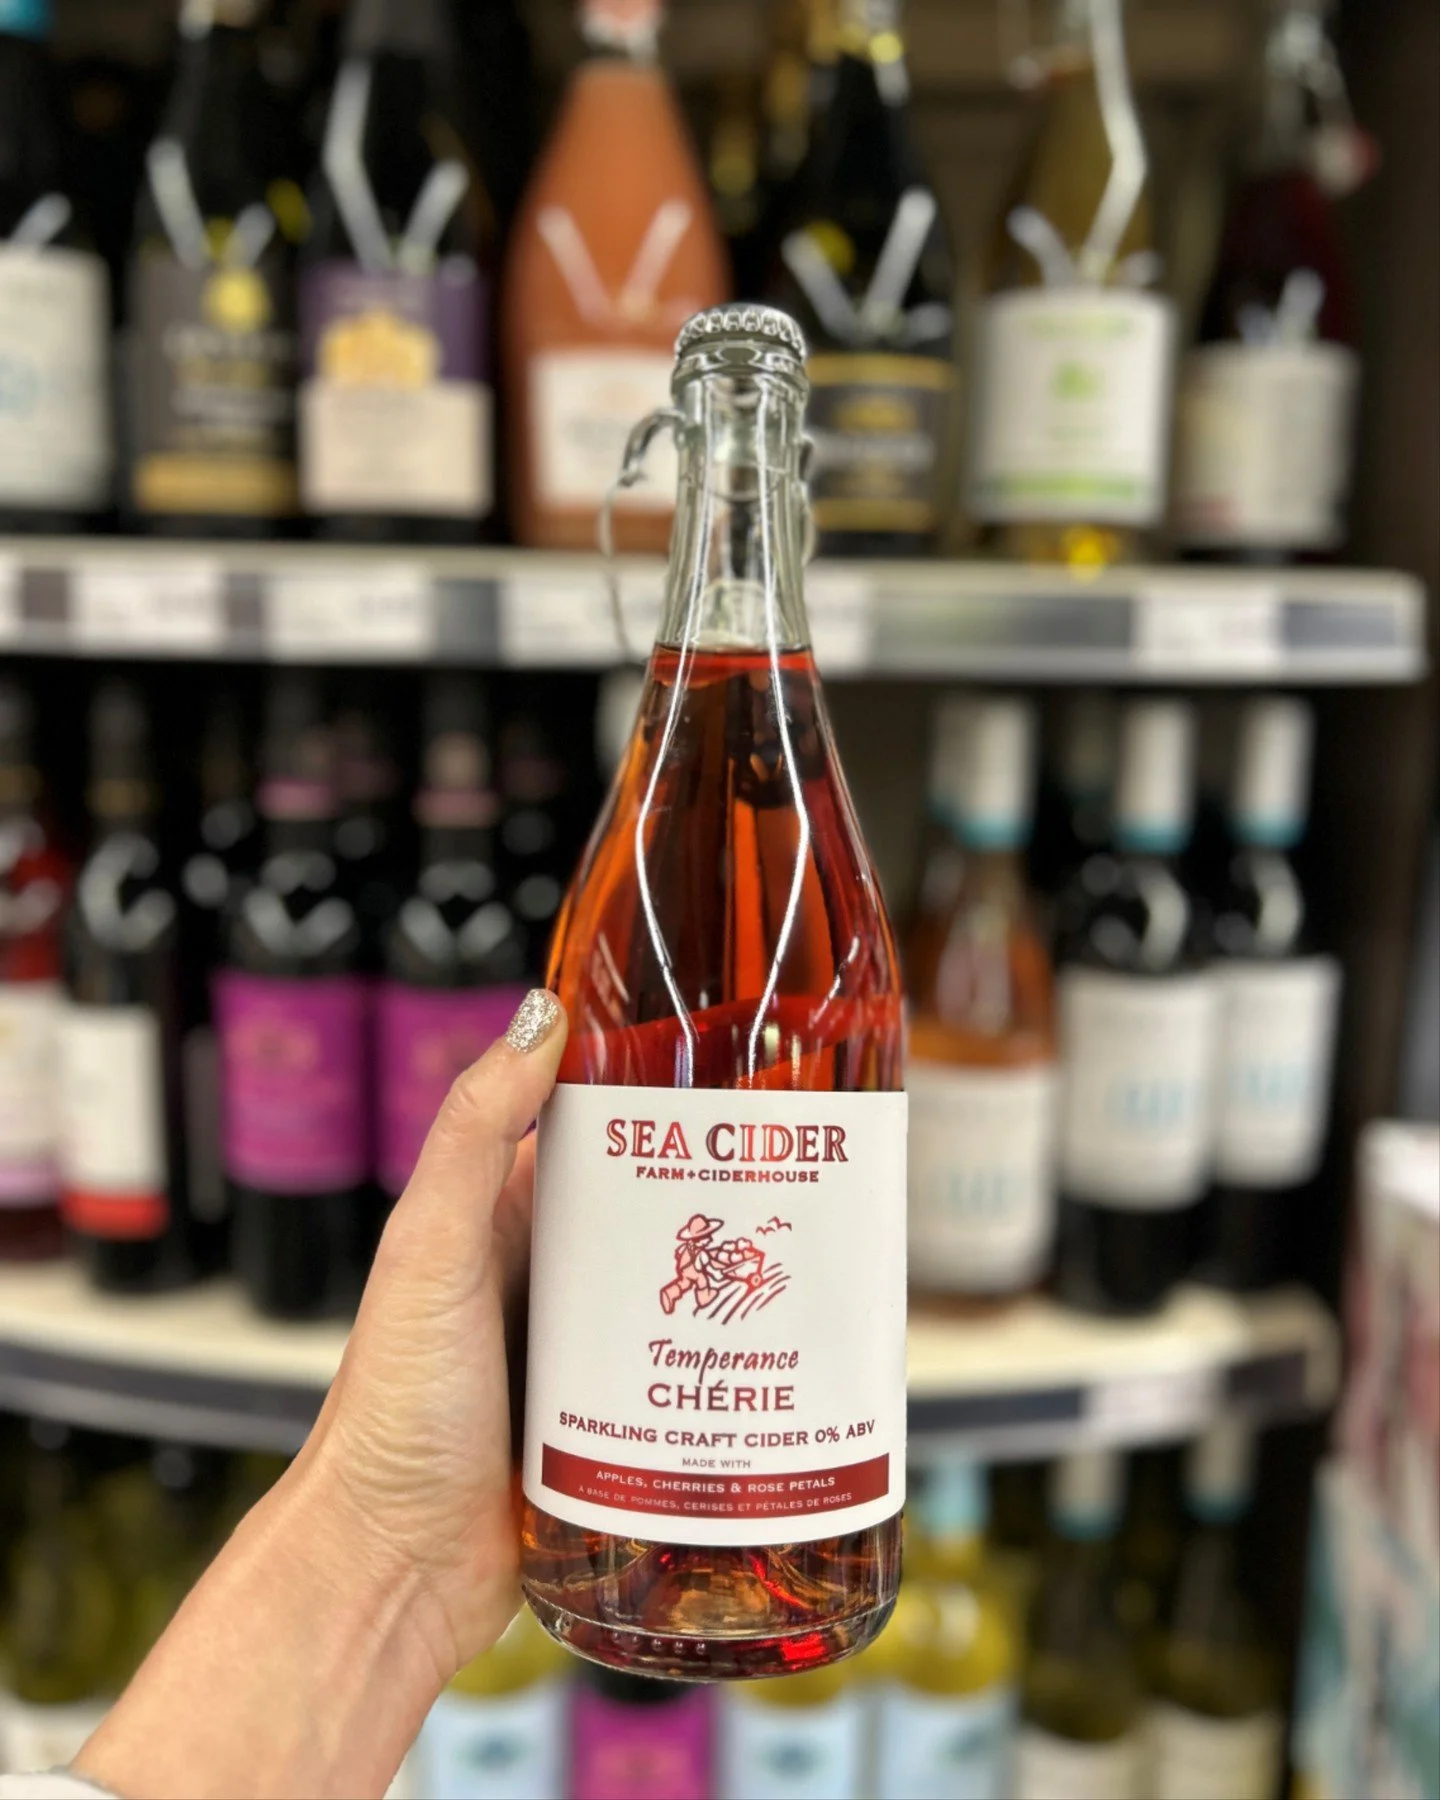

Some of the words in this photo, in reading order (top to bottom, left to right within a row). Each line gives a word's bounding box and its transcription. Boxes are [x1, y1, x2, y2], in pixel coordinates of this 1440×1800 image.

[606, 1118, 693, 1160] SEA
[705, 1122, 849, 1163] CIDER
[648, 1338, 799, 1386] Temperance
[647, 1379, 795, 1412] CHÉRIE
[559, 1411, 658, 1443] SPARKLING
[664, 1430, 737, 1448] CRAFT
[744, 1431, 808, 1448] CIDER
[814, 1426, 840, 1444] 0%
[845, 1419, 875, 1440] ABV
[682, 1457, 716, 1468] MADE
[720, 1459, 752, 1469] WITH
[596, 1470, 648, 1489] APPLES,
[652, 1479, 725, 1494] CHERRIES
[730, 1482, 741, 1493] &
[748, 1482, 785, 1493] ROSE
[789, 1476, 836, 1492] PETALS
[586, 1487, 609, 1500] BASE
[613, 1493, 626, 1502] DE
[630, 1496, 680, 1510] POMMES,
[683, 1501, 734, 1512] CERISES
[738, 1503, 751, 1512] ET
[806, 1498, 820, 1507] DE
[822, 1492, 852, 1505] ROSES
